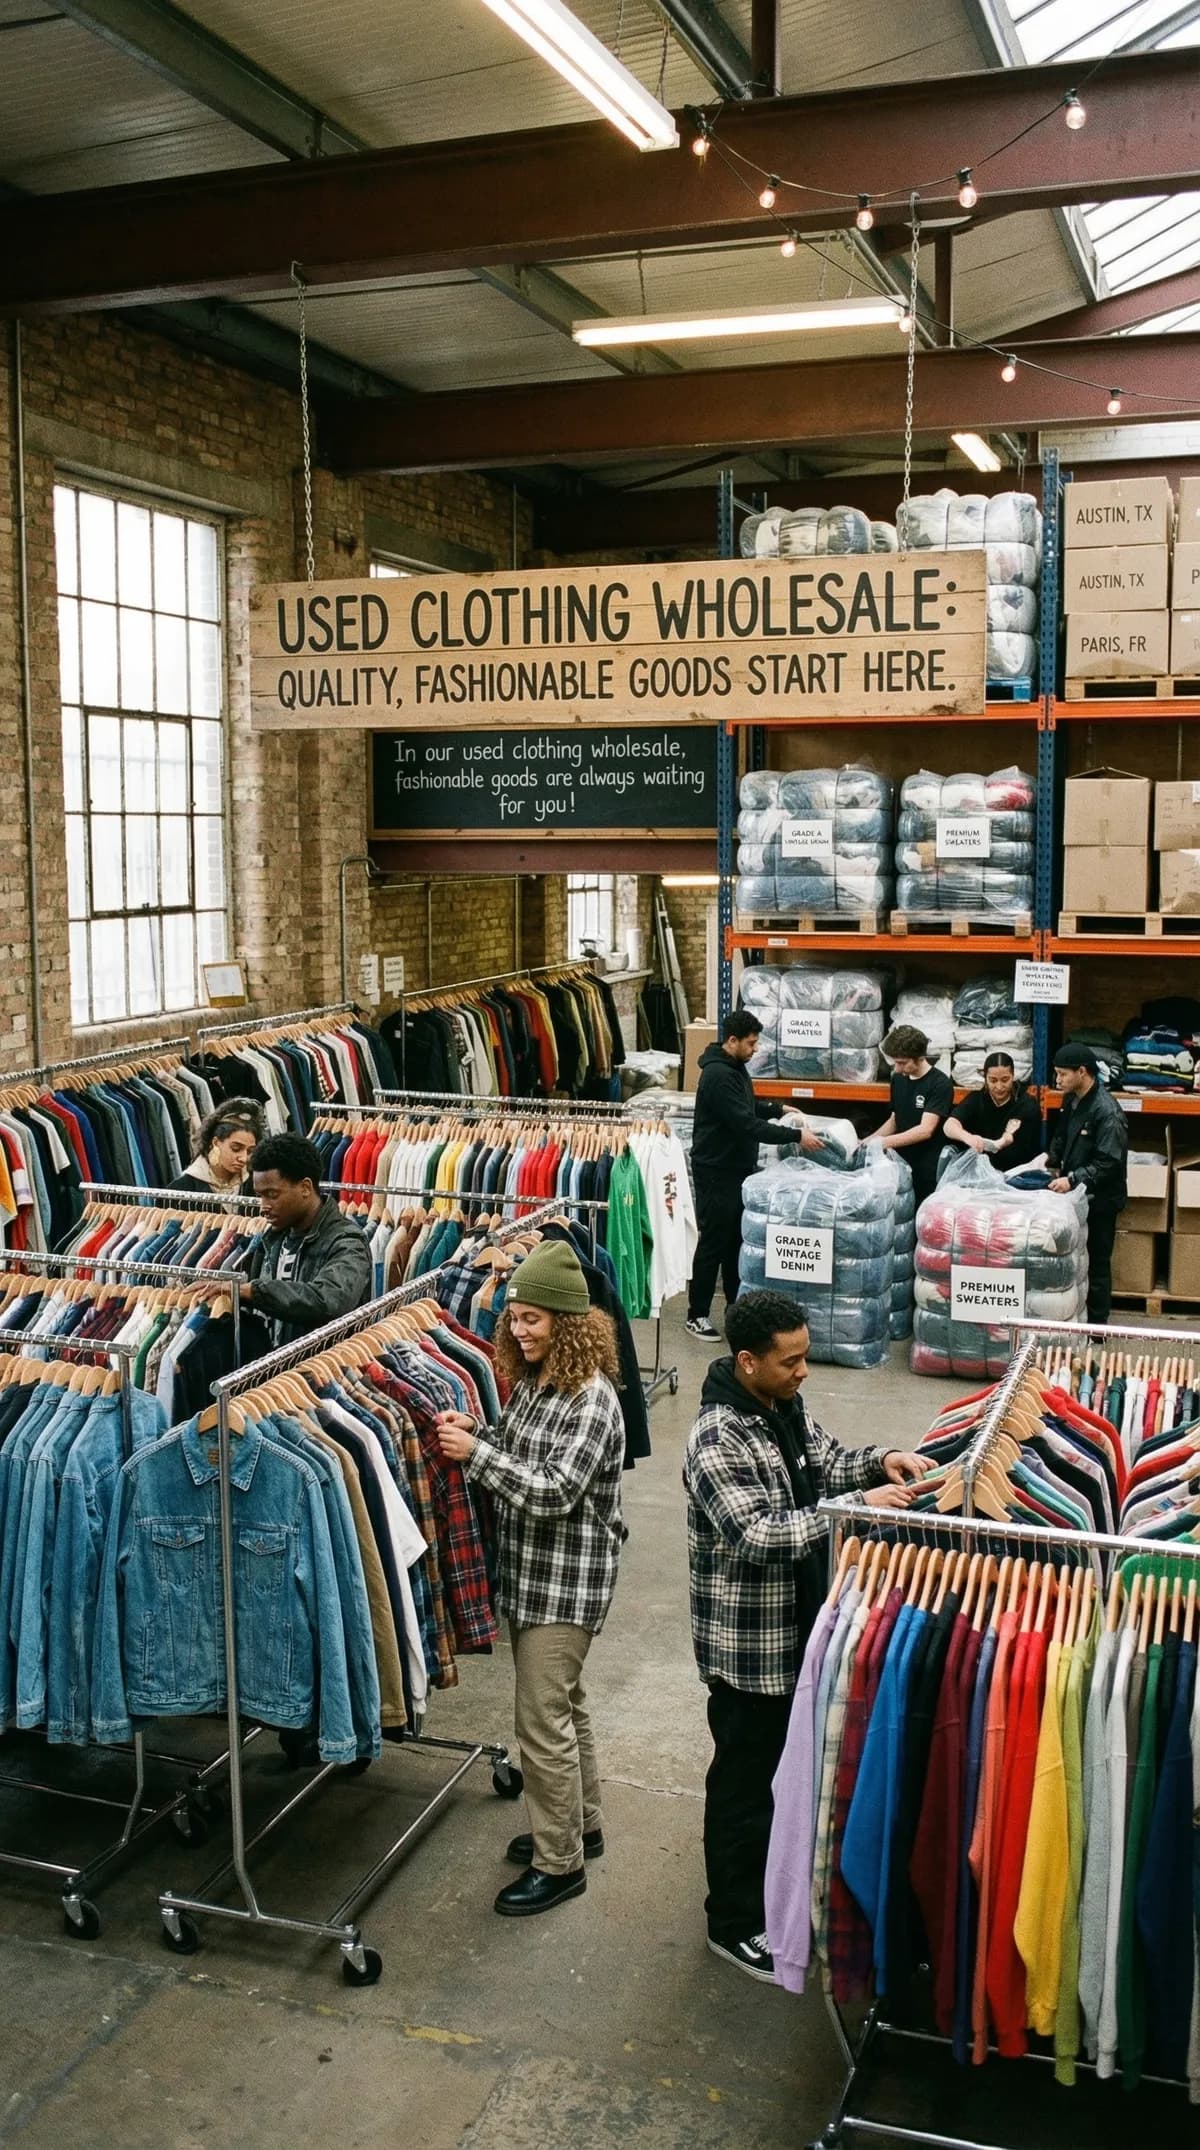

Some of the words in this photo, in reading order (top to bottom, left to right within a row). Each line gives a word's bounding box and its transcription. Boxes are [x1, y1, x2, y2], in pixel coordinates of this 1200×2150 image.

[1076, 507, 1130, 525] AUSTIN,
[1135, 505, 1153, 522] TX
[1079, 574, 1126, 590] AUSTIN,
[1129, 573, 1145, 587] TX
[277, 594, 389, 654] USED
[410, 582, 630, 648] CLOTHING
[652, 568, 957, 640] WHOLESALE:
[1081, 636, 1124, 655] PARIS,
[1129, 636, 1147, 652] FR
[278, 667, 403, 711] QUALITY,
[416, 659, 614, 703] FASHIONABLE
[629, 656, 732, 698] GOODS
[748, 653, 848, 695] START
[864, 649, 956, 692] HERE.
[394, 740, 416, 763] In
[425, 747, 454, 761] our
[463, 738, 504, 761] used
[512, 735, 582, 768] clothing
[591, 733, 686, 759] wholesale,
[394, 767, 484, 793] fashionable
[491, 765, 538, 796] goods
[546, 773, 573, 787] are
[579, 764, 635, 794] always
[643, 763, 705, 794] waiting
[499, 793, 525, 821] for
[534, 791, 576, 822] you!
[775, 1234, 810, 1248] GRADE
[812, 1238, 822, 1249] A
[776, 1247, 822, 1261] VINTAGE
[780, 1260, 815, 1273] DENIM
[960, 1281, 1016, 1294] PREMIUM
[956, 1293, 1020, 1308] SWEATERS
